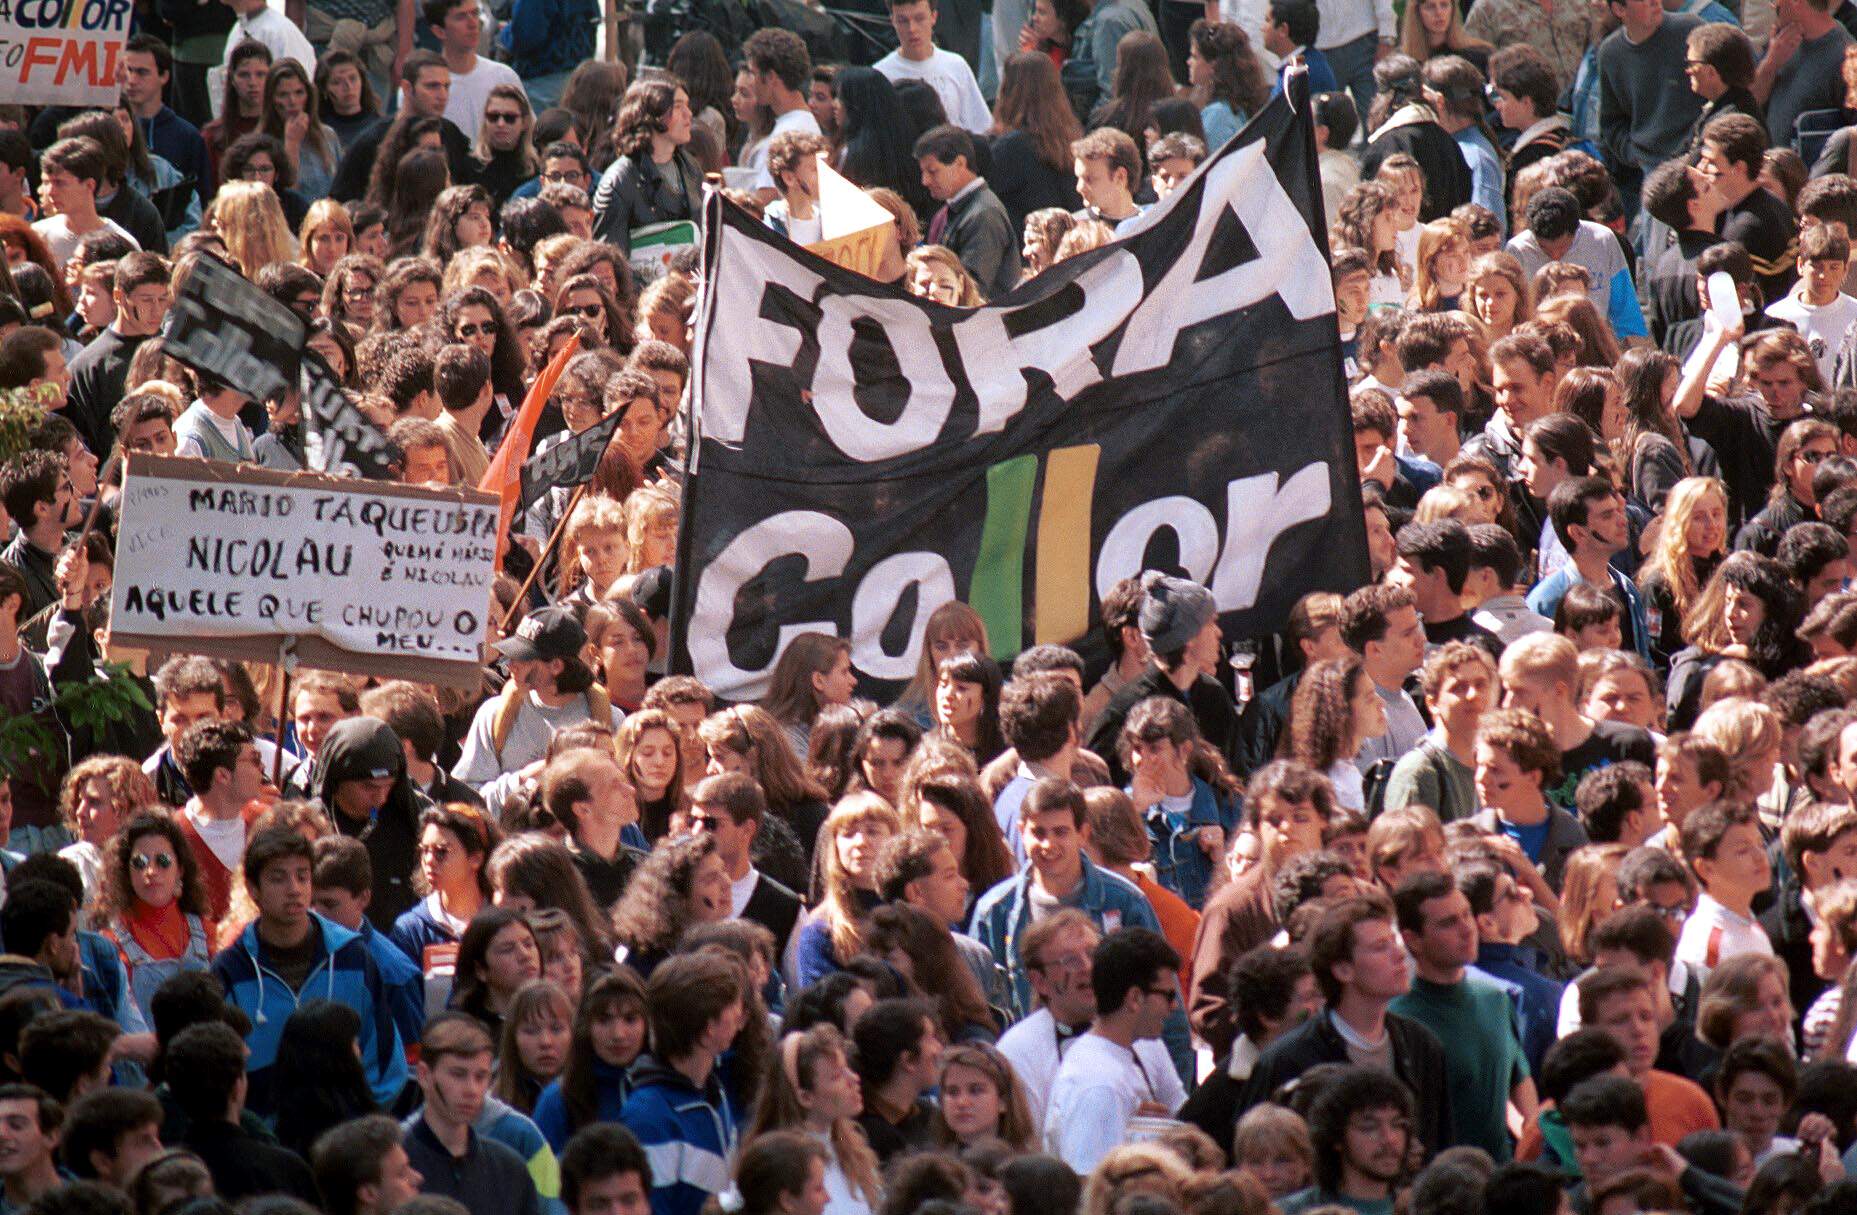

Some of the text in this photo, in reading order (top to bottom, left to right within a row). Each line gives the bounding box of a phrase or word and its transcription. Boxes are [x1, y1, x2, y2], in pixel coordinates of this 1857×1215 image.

[18, 36, 122, 88] FMI
[700, 137, 1336, 462] FORA
[188, 487, 294, 518] MARIO
[186, 535, 352, 577] NICOLAU
[687, 442, 1332, 700] Collor
[124, 585, 478, 636] AQUELE QUE CHUPOU O
